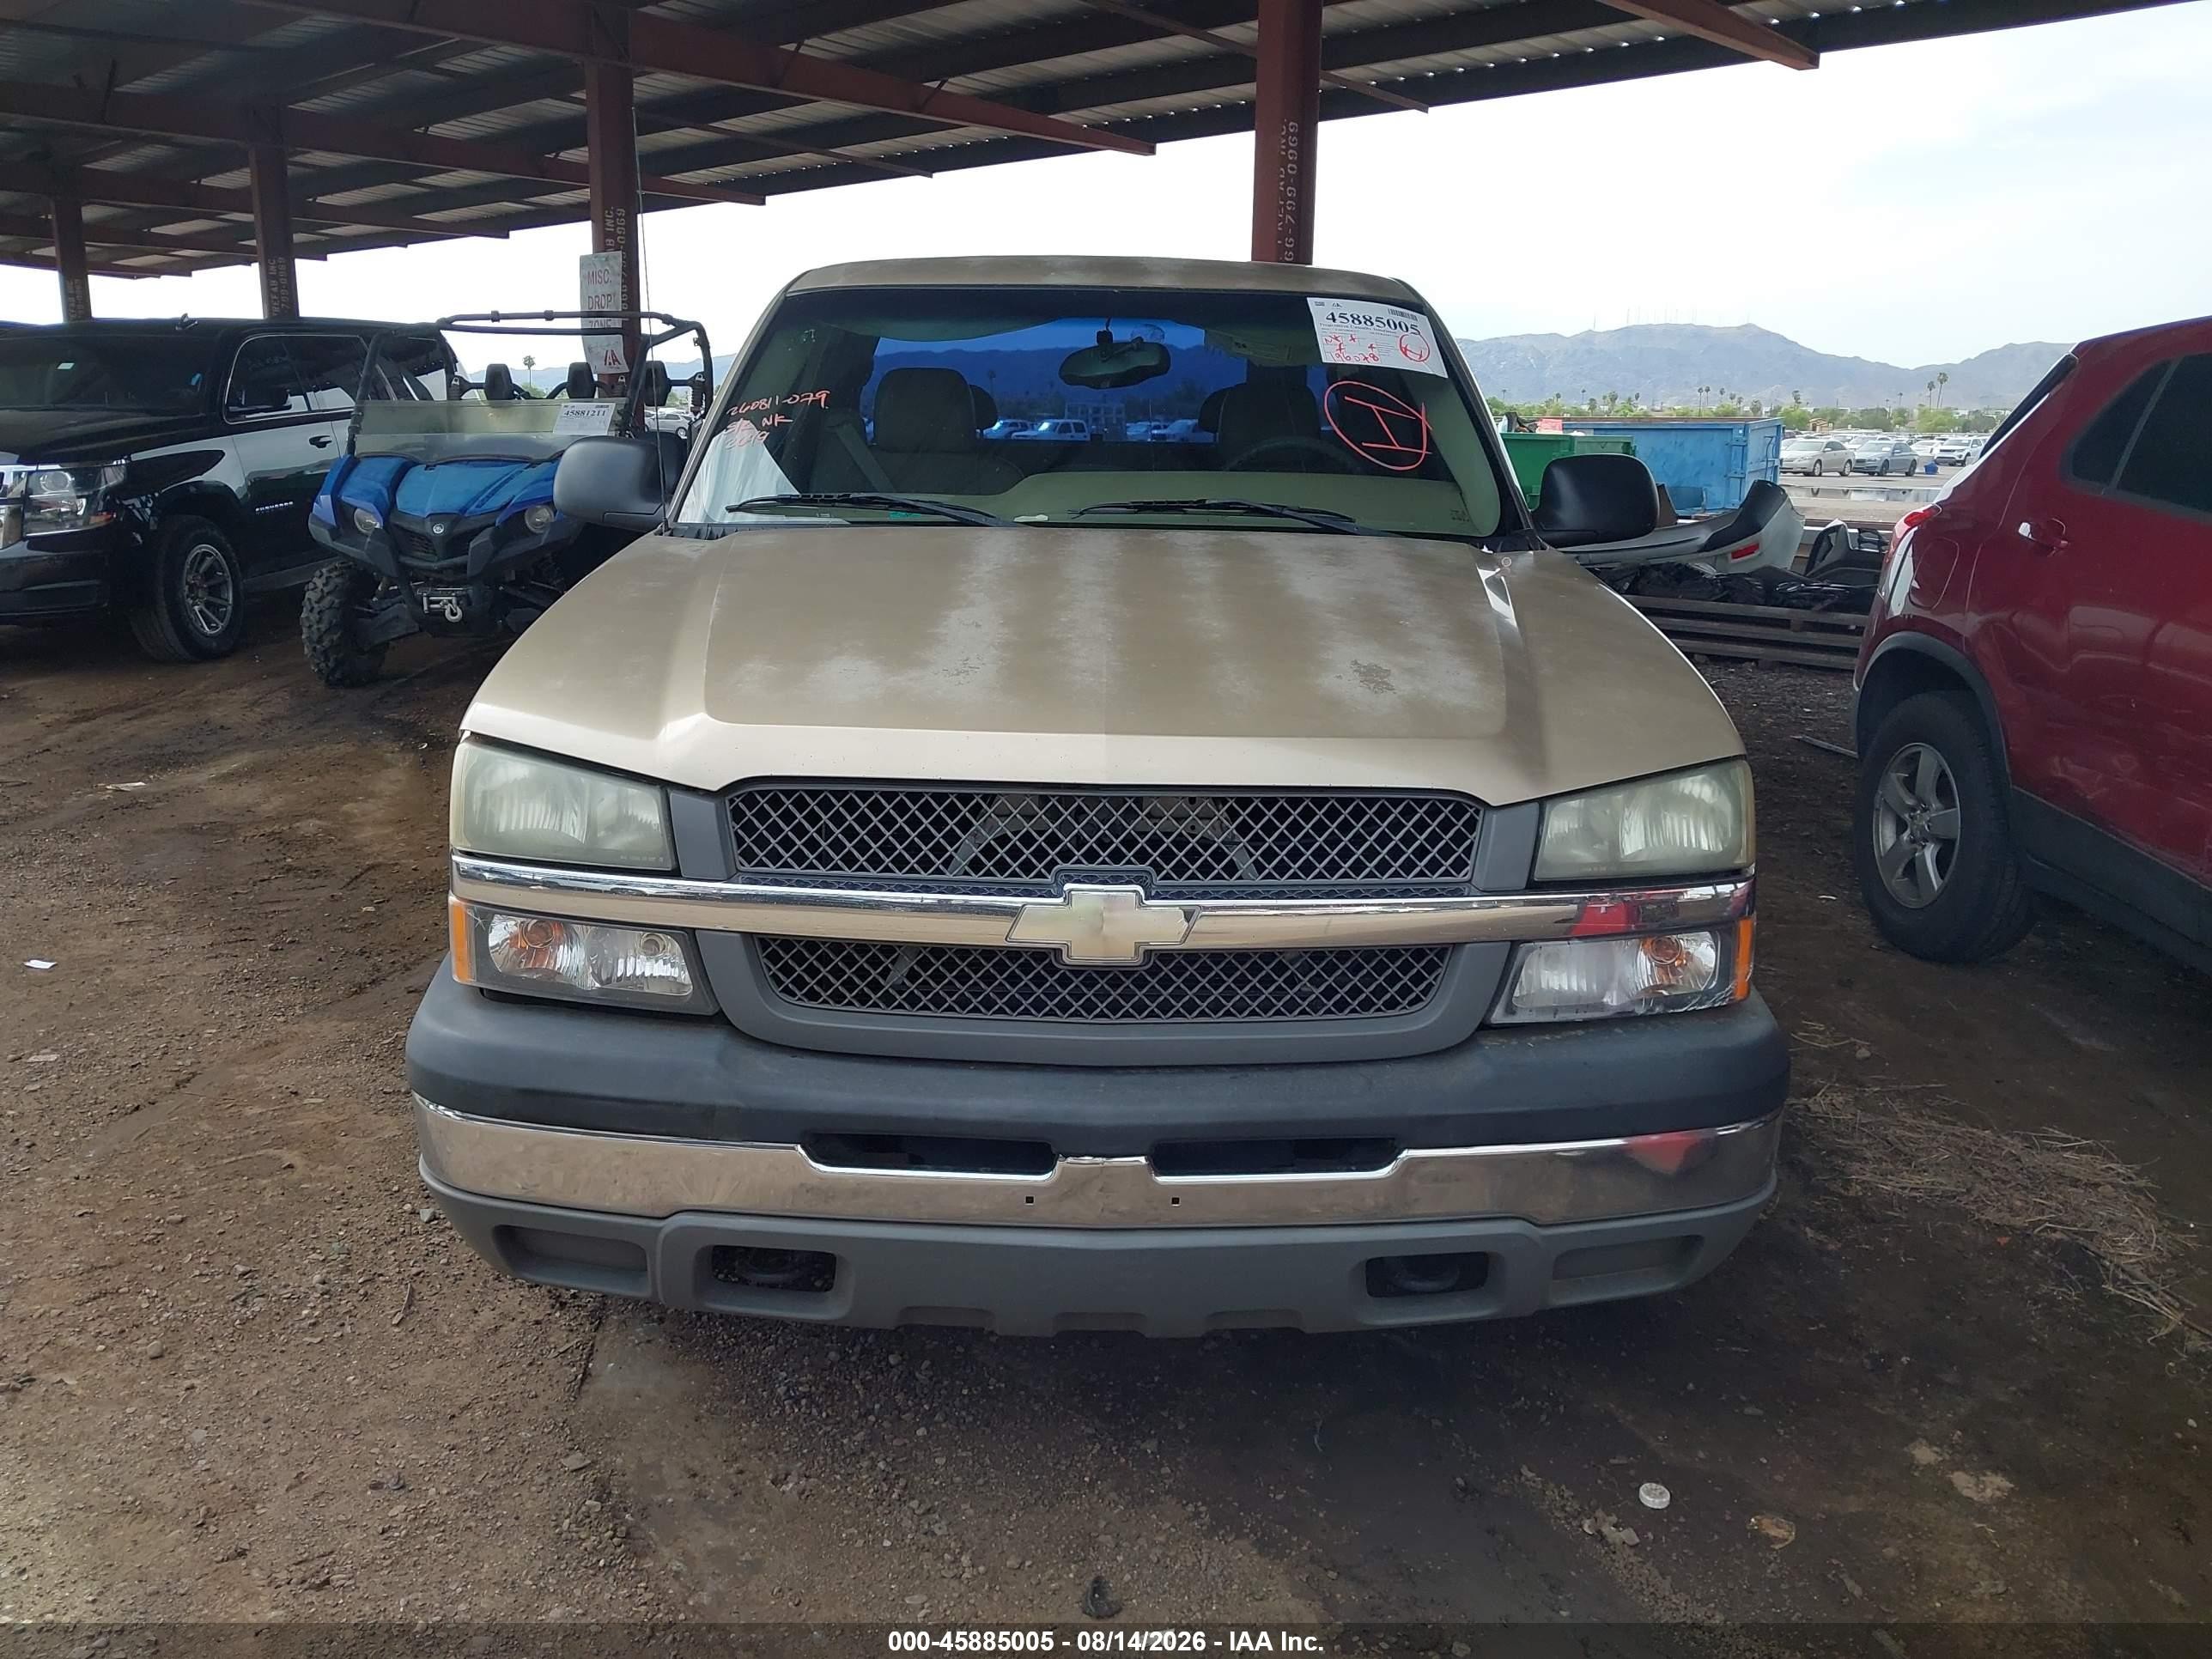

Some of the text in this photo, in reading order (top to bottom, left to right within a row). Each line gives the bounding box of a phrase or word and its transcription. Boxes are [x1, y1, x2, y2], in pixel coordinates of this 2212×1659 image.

[587, 269, 612, 286] MISC.
[587, 293, 612, 310] DROP
[1326, 312, 1421, 336] 45885005
